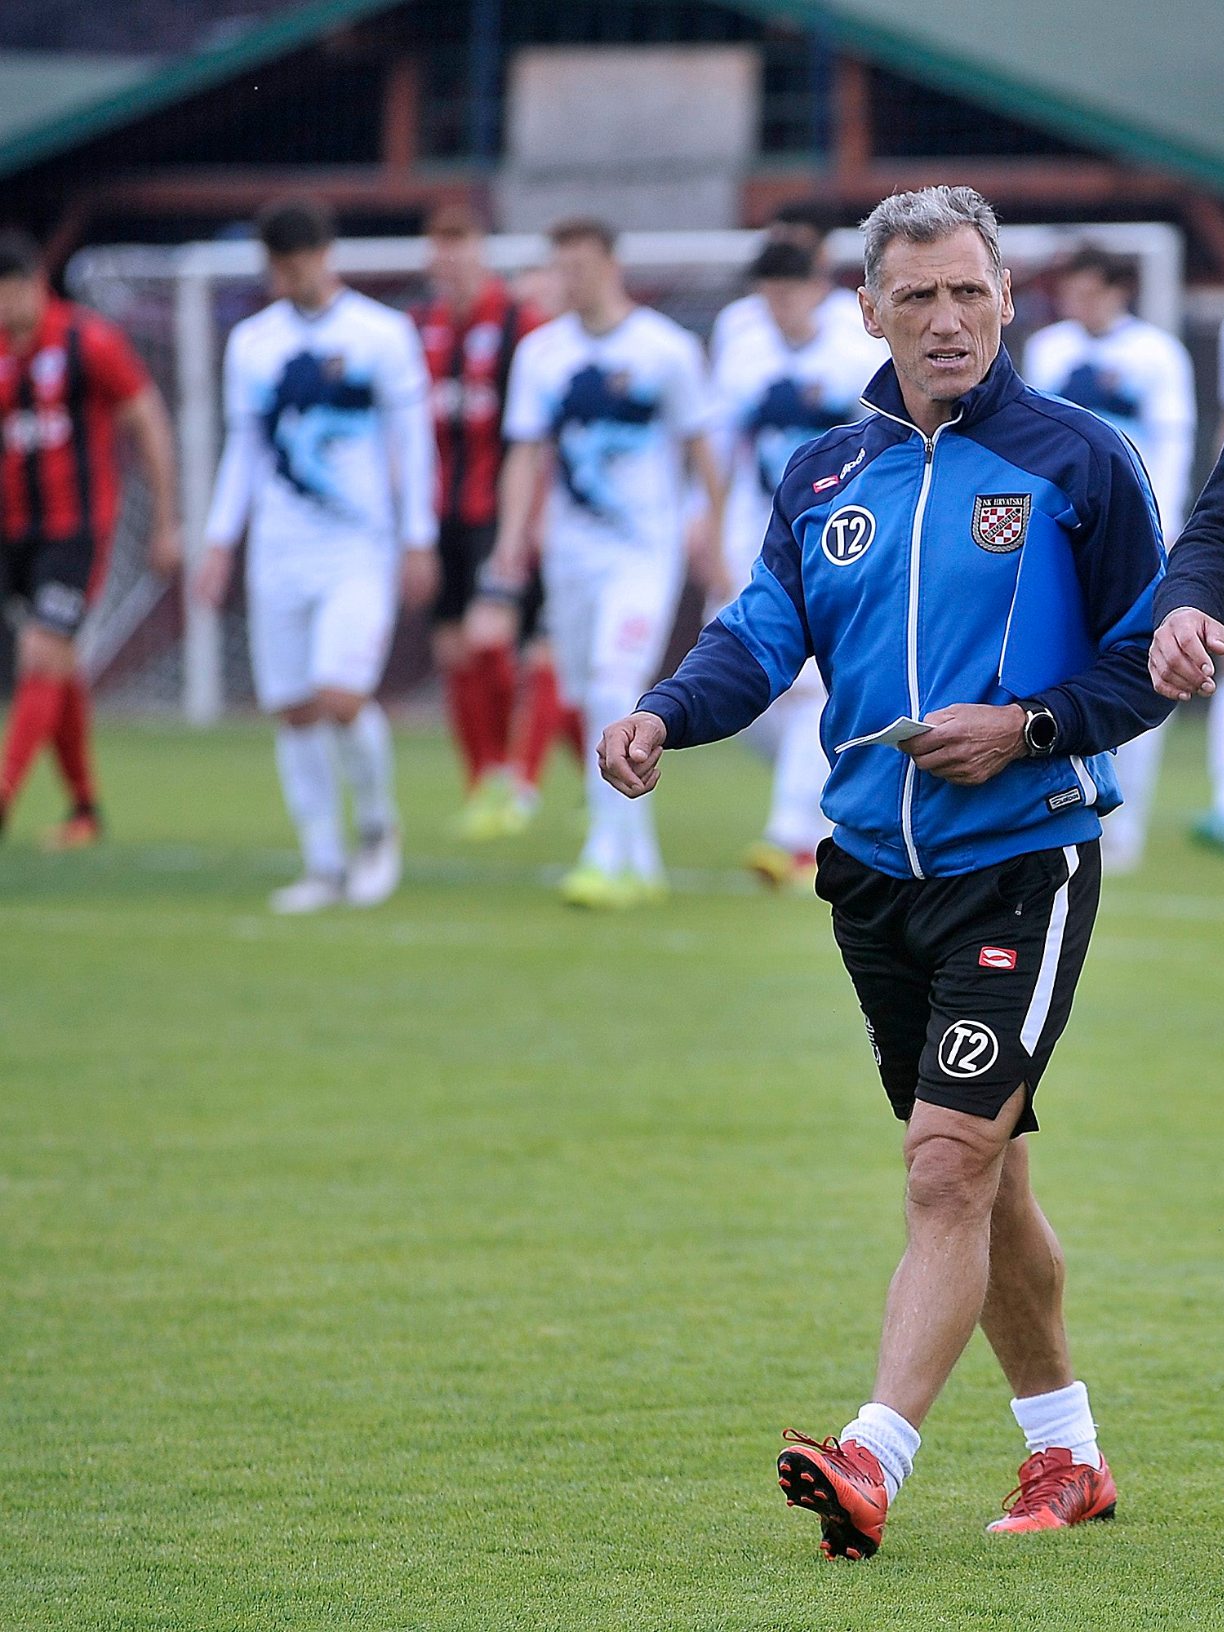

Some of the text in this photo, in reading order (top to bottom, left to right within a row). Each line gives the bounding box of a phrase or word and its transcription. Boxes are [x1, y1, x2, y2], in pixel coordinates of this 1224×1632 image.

[993, 498, 1023, 506] HRVATSKI
[832, 516, 866, 557] T2
[946, 1026, 989, 1072] T2
